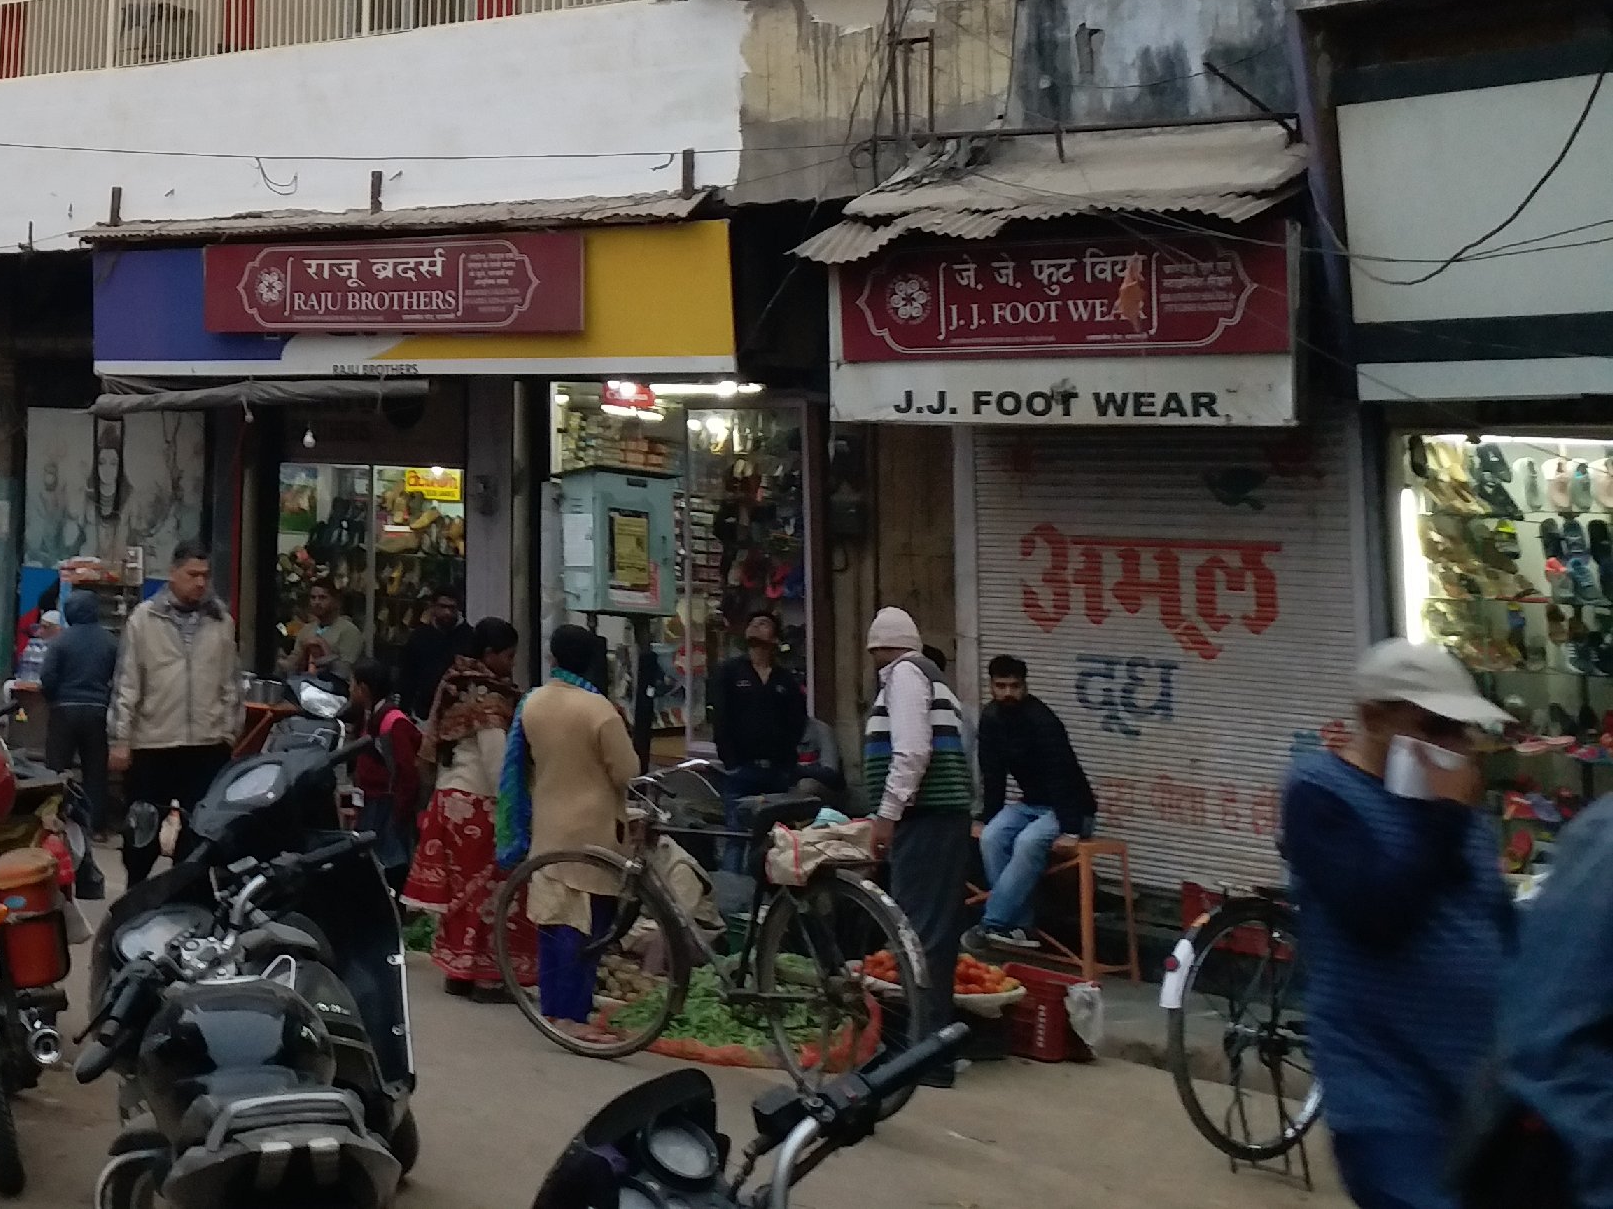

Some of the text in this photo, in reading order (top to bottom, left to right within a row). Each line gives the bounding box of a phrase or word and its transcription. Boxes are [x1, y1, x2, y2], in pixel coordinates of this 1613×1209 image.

[302, 258, 366, 288] राजू
[368, 247, 447, 282] ब्रदर्स
[952, 253, 984, 291] जे.
[990, 252, 1022, 289] जे.
[1030, 257, 1078, 296] फुट
[293, 289, 456, 315] RAJU BROTHERS
[948, 303, 966, 331] J.
[969, 302, 987, 330] J.
[991, 300, 1064, 325] FOOT
[892, 389, 1222, 419] J.J. FOOT WEAR
[1020, 524, 1285, 660] अमूल
[1075, 656, 1181, 738] दूध
